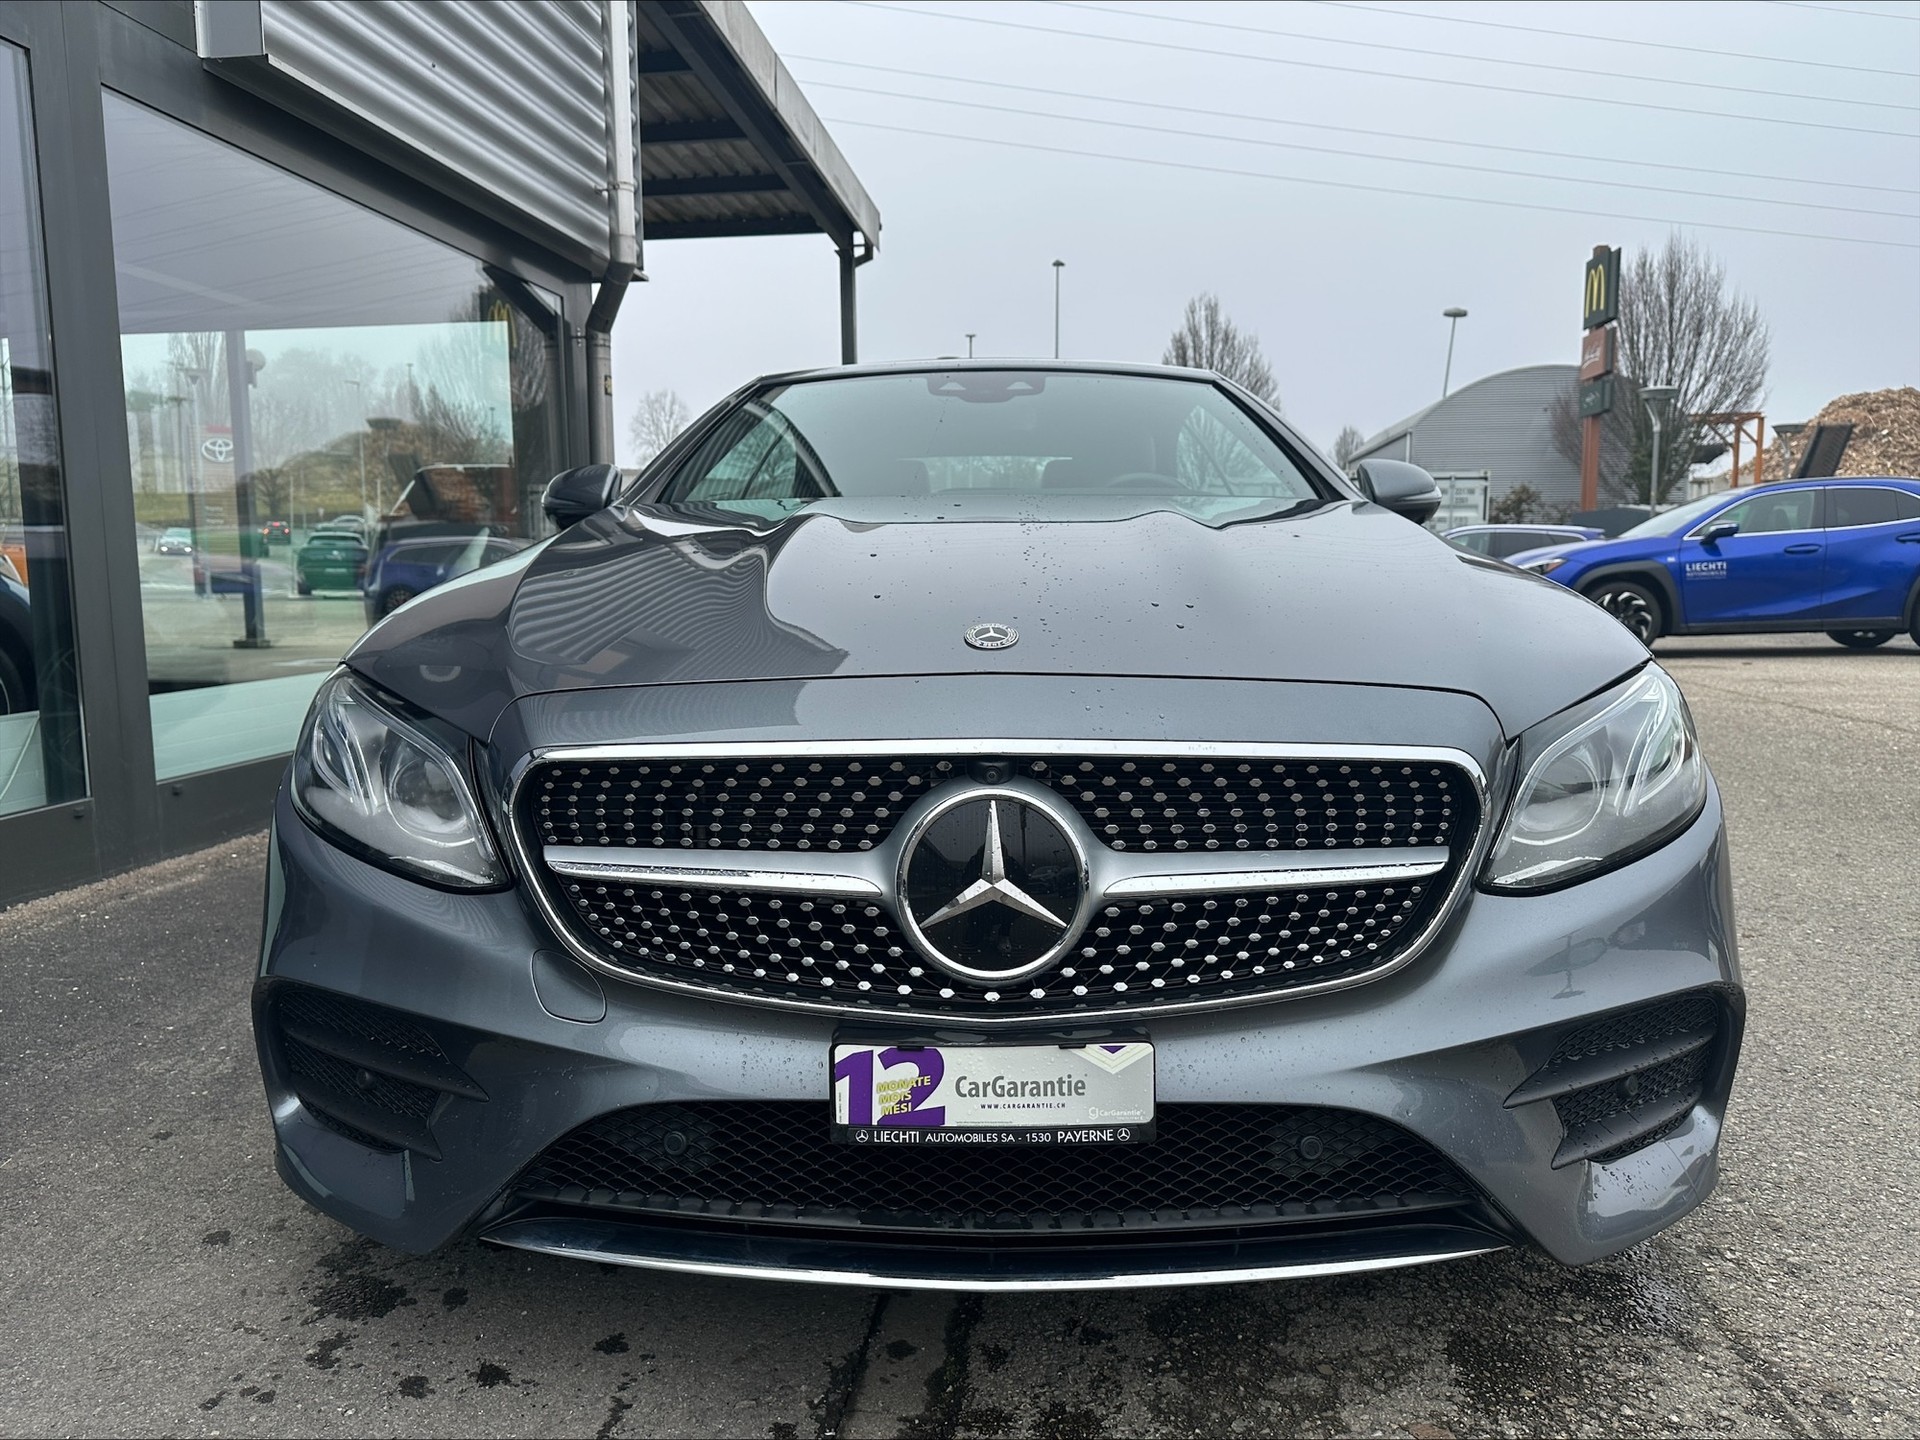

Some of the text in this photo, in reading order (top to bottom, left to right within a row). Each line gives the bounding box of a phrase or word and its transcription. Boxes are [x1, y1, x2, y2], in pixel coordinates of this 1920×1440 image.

[1685, 561, 1727, 572] LIECHTI
[835, 1048, 945, 1126] 12
[877, 1075, 931, 1094] MONATE
[955, 1073, 1086, 1098] CarGarantie
[878, 1089, 912, 1105] MOIS
[881, 1102, 912, 1117] MESI
[873, 1130, 920, 1143] LIECHTI
[925, 1132, 998, 1143] AUTOMOBILES
[1000, 1132, 1016, 1143] SA
[1025, 1132, 1052, 1143] 1530
[1057, 1129, 1115, 1143] PAYERNE
